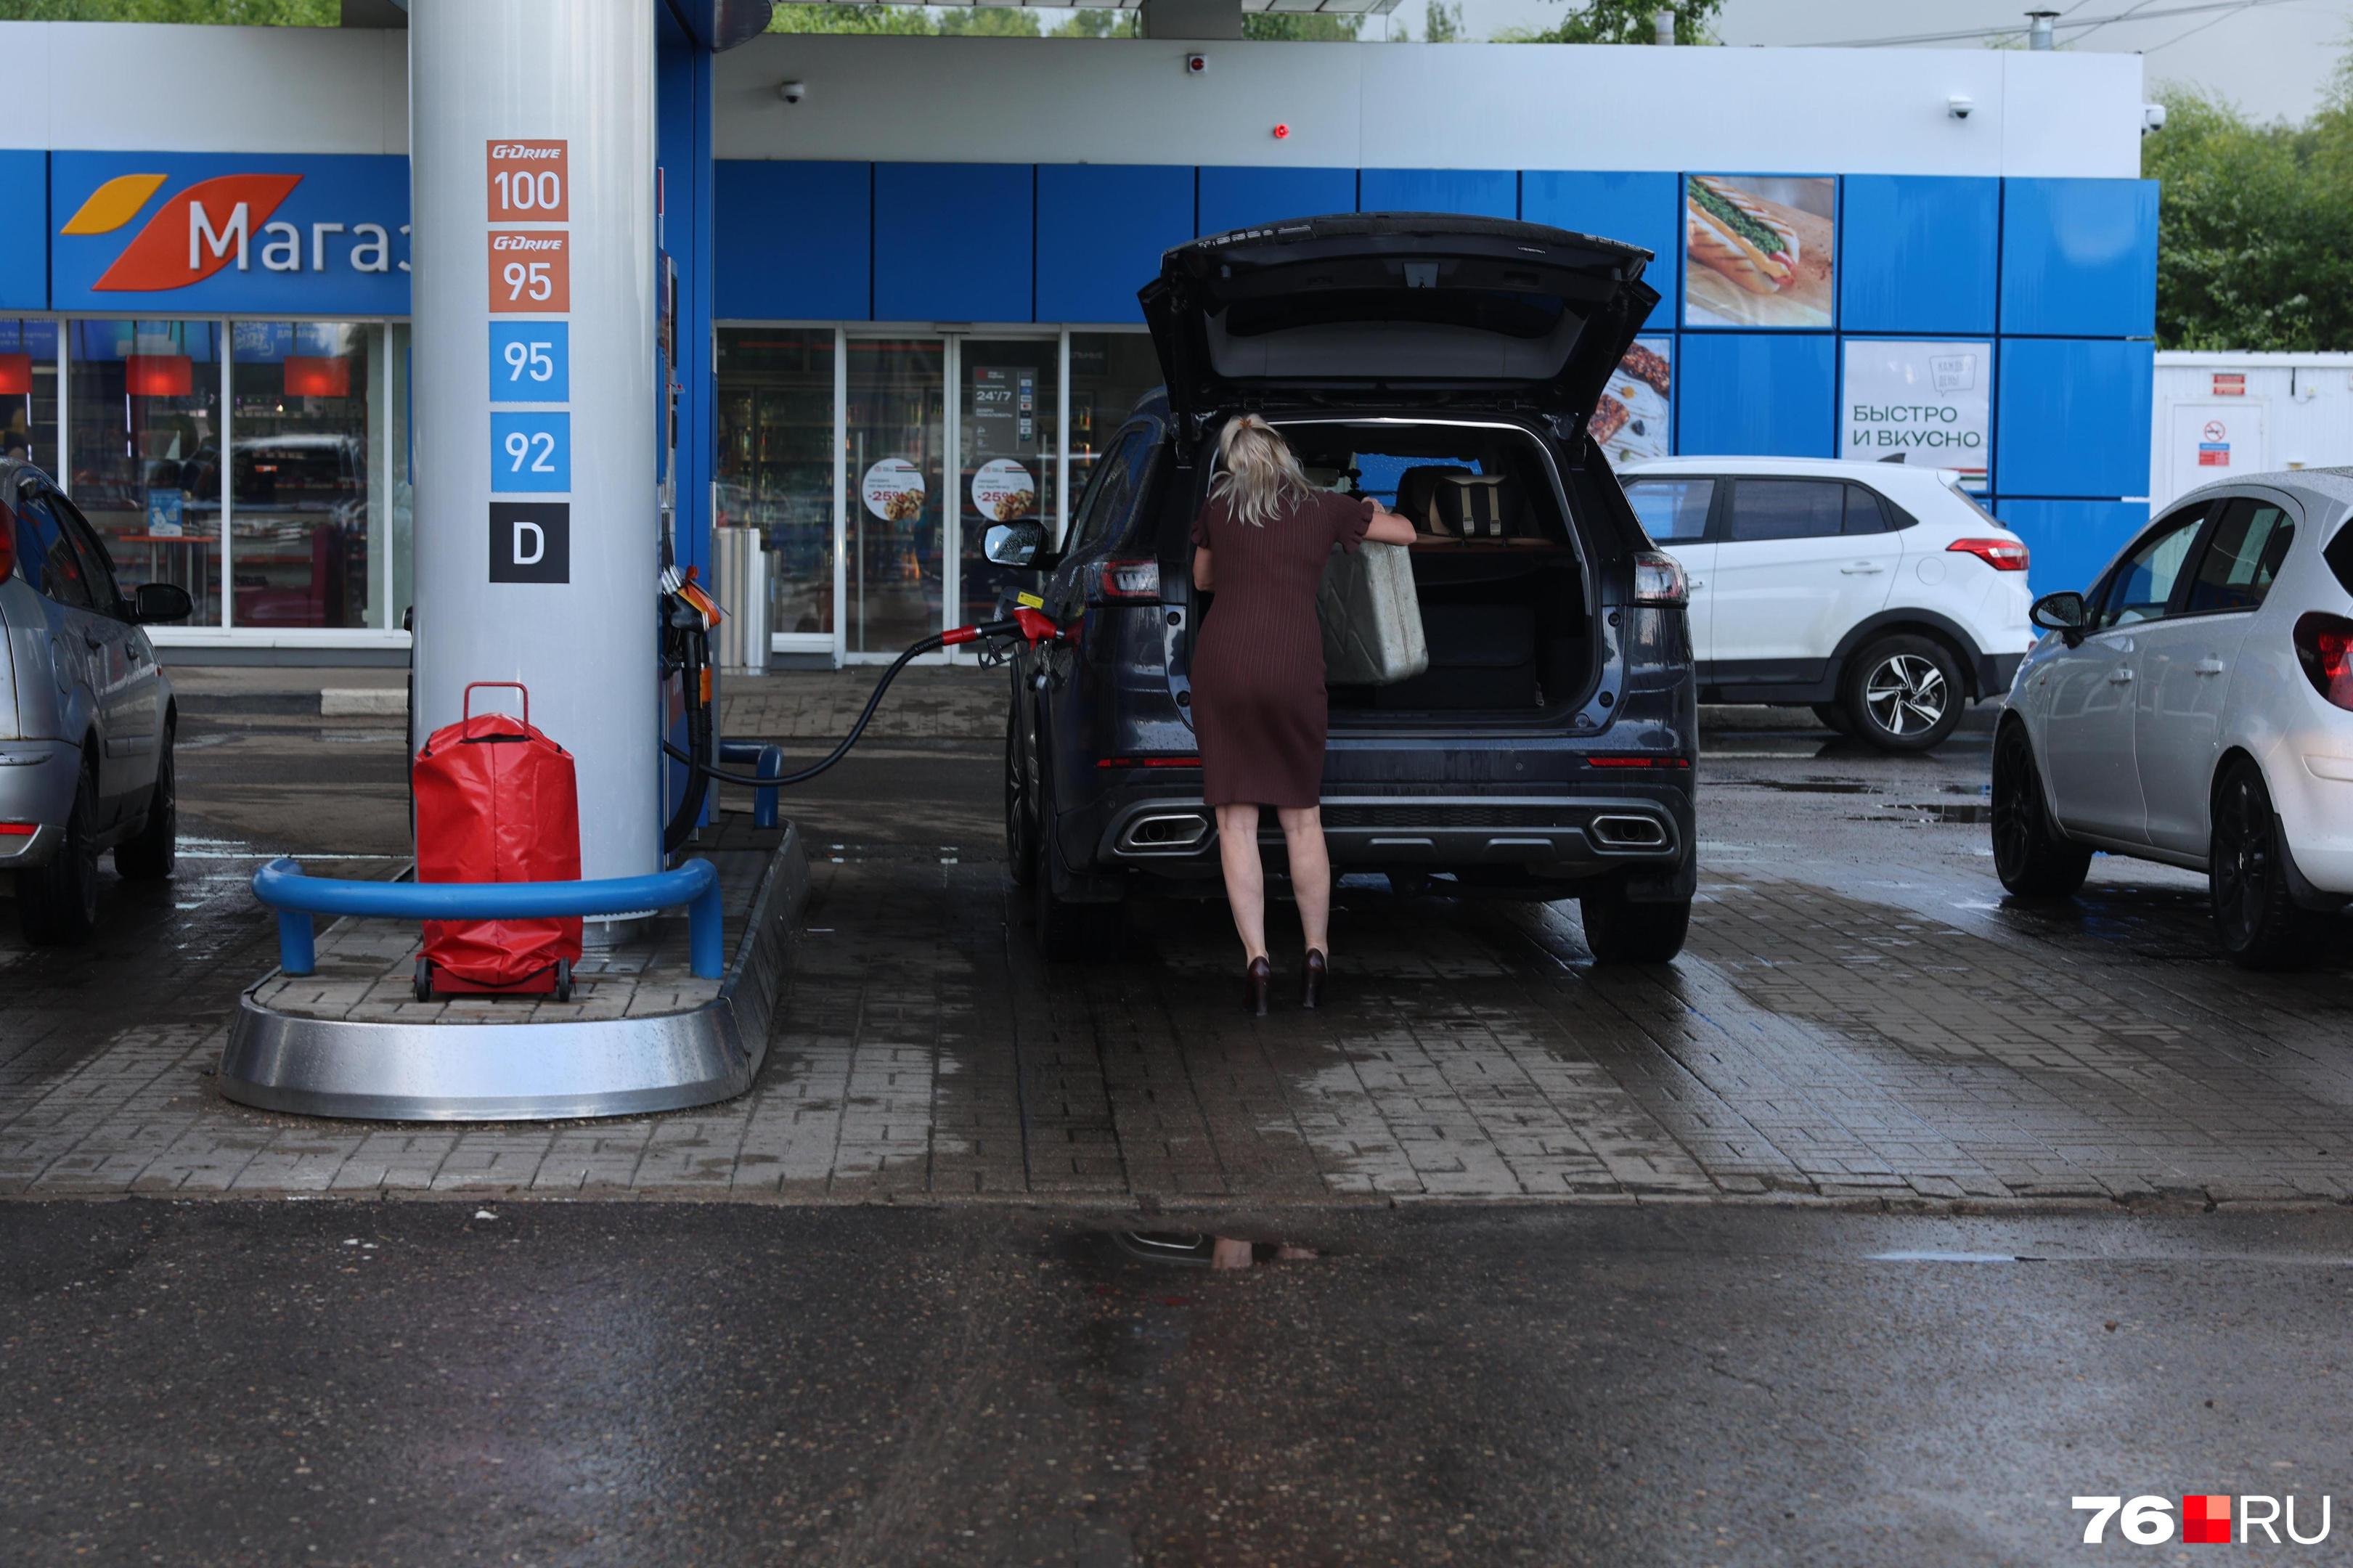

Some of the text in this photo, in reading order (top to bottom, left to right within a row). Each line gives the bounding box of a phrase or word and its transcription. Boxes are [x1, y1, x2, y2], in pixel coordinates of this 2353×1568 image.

[494, 171, 560, 209] 100
[503, 262, 552, 301] 95
[504, 341, 553, 381] 95
[1938, 360, 1970, 372] КАЖДЫ
[1854, 405, 1958, 423] БЫСТРО
[505, 432, 555, 472] 92
[1853, 429, 1981, 448] И ВКУСНО
[513, 521, 545, 565] D
